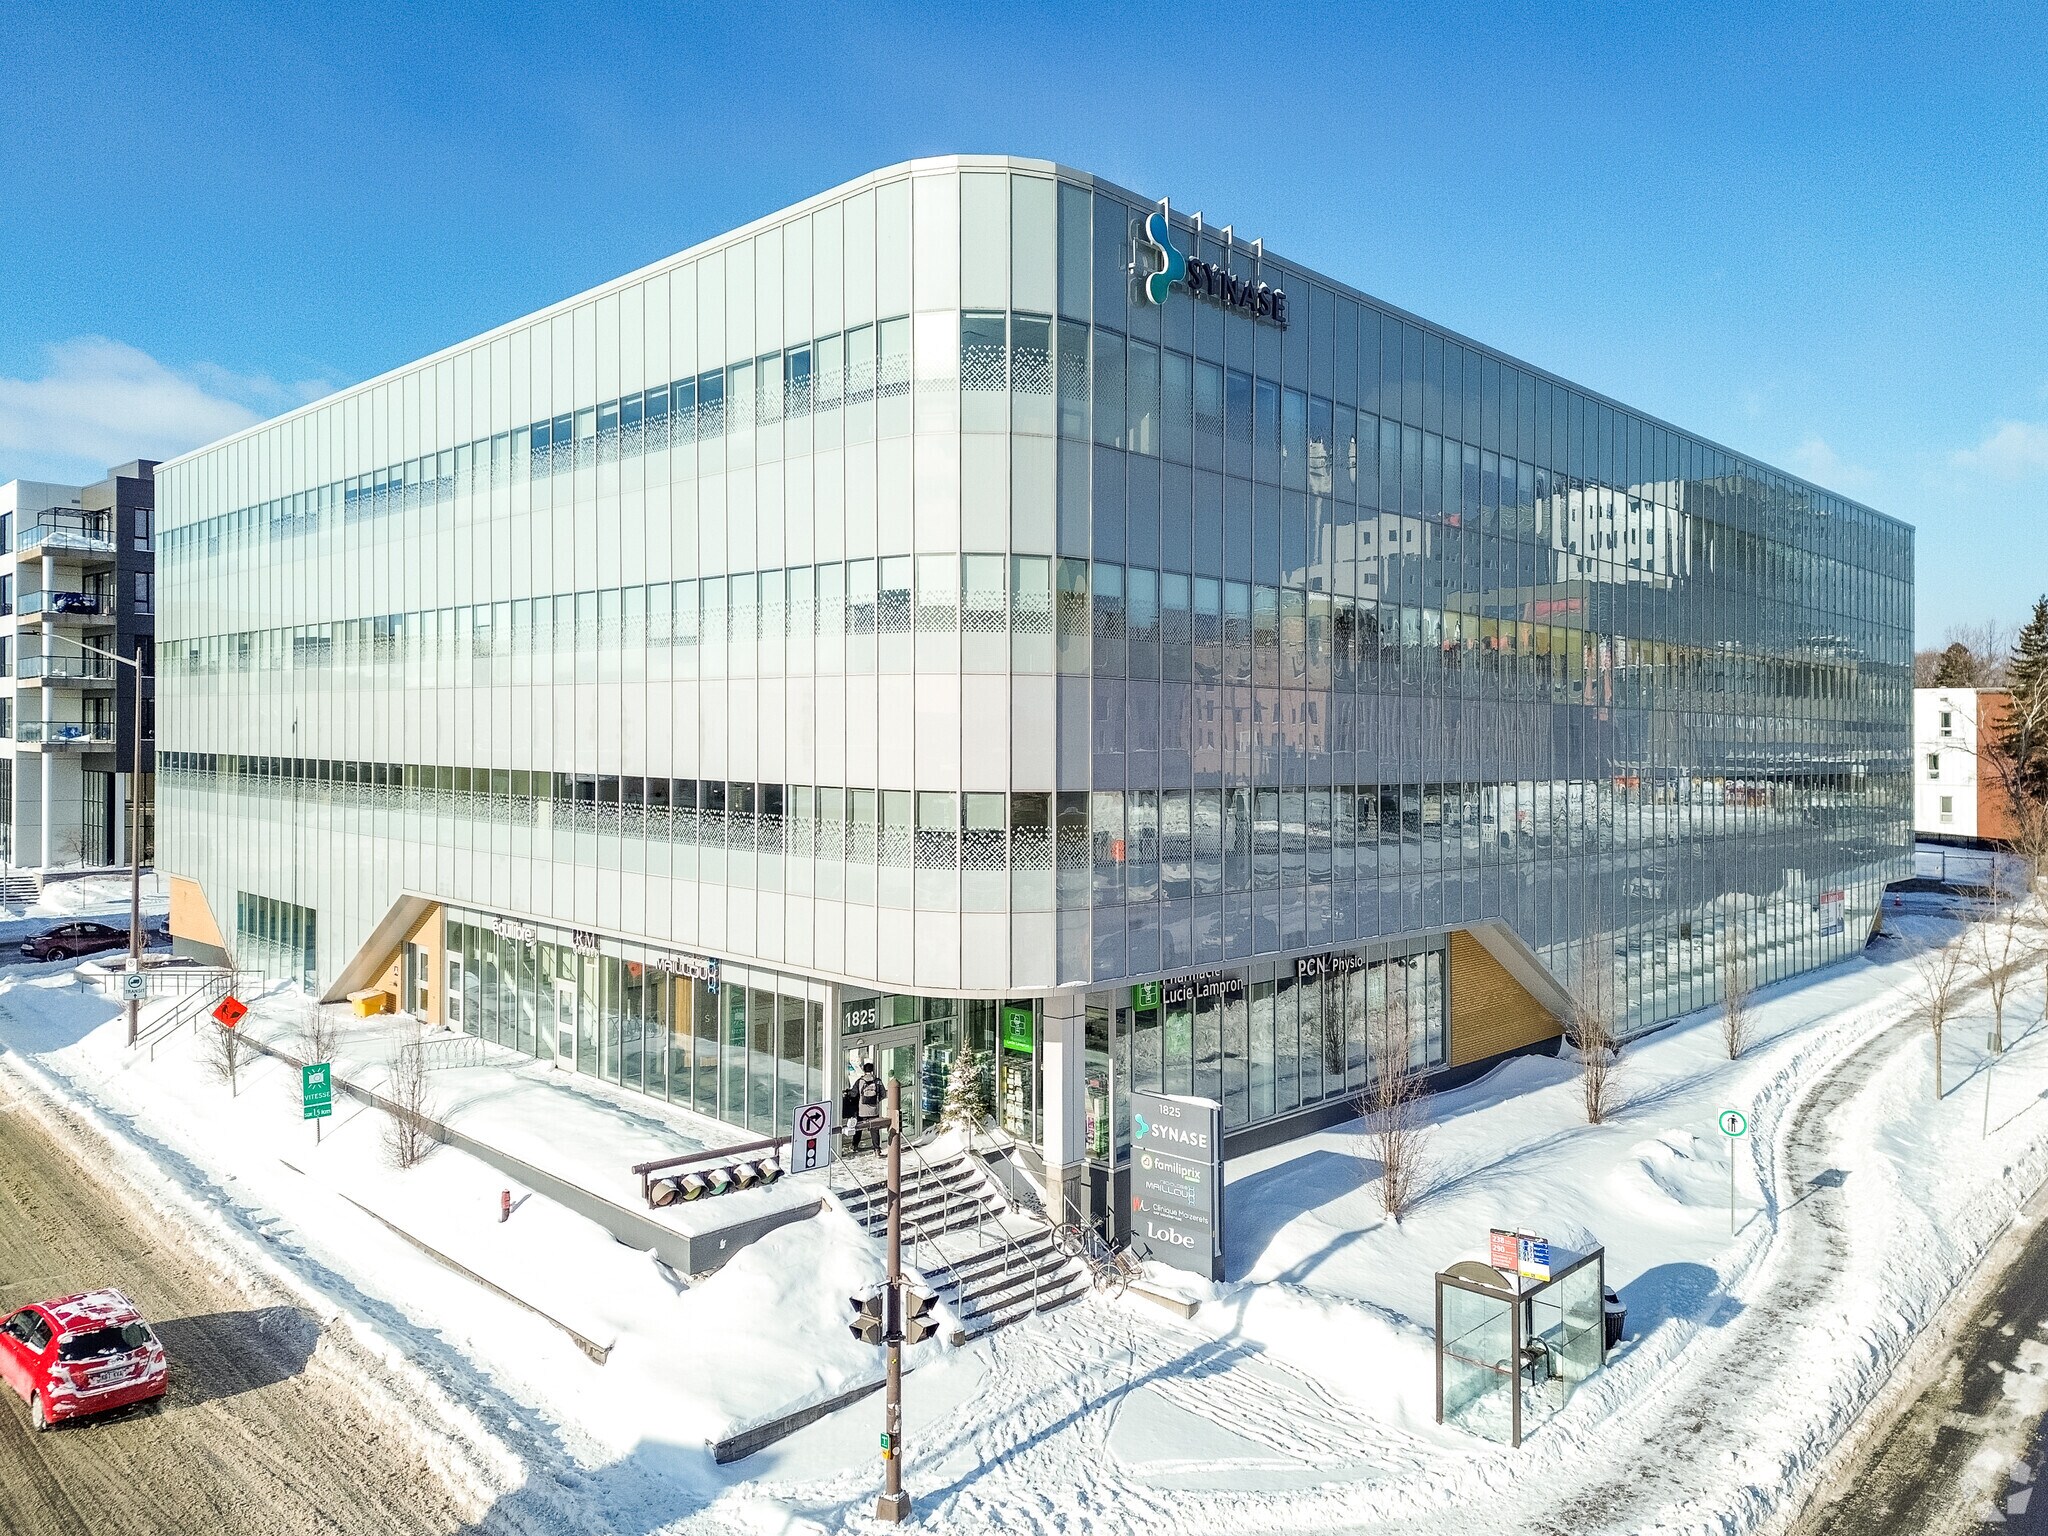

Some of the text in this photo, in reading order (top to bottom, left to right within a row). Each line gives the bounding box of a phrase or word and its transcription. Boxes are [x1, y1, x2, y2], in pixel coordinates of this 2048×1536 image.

[1187, 256, 1287, 323] SYNASE
[1298, 955, 1363, 976] PCN Physio
[1163, 978, 1244, 1004] Lucie Lampron
[845, 1008, 876, 1028] 1825
[304, 1091, 330, 1100] VITESSE
[1158, 1104, 1181, 1118] 1825
[1151, 1123, 1208, 1149] SYNASE
[1153, 1157, 1201, 1179] familiprix
[1152, 1203, 1178, 1216] Clinique
[1146, 1221, 1195, 1250] Lobe
